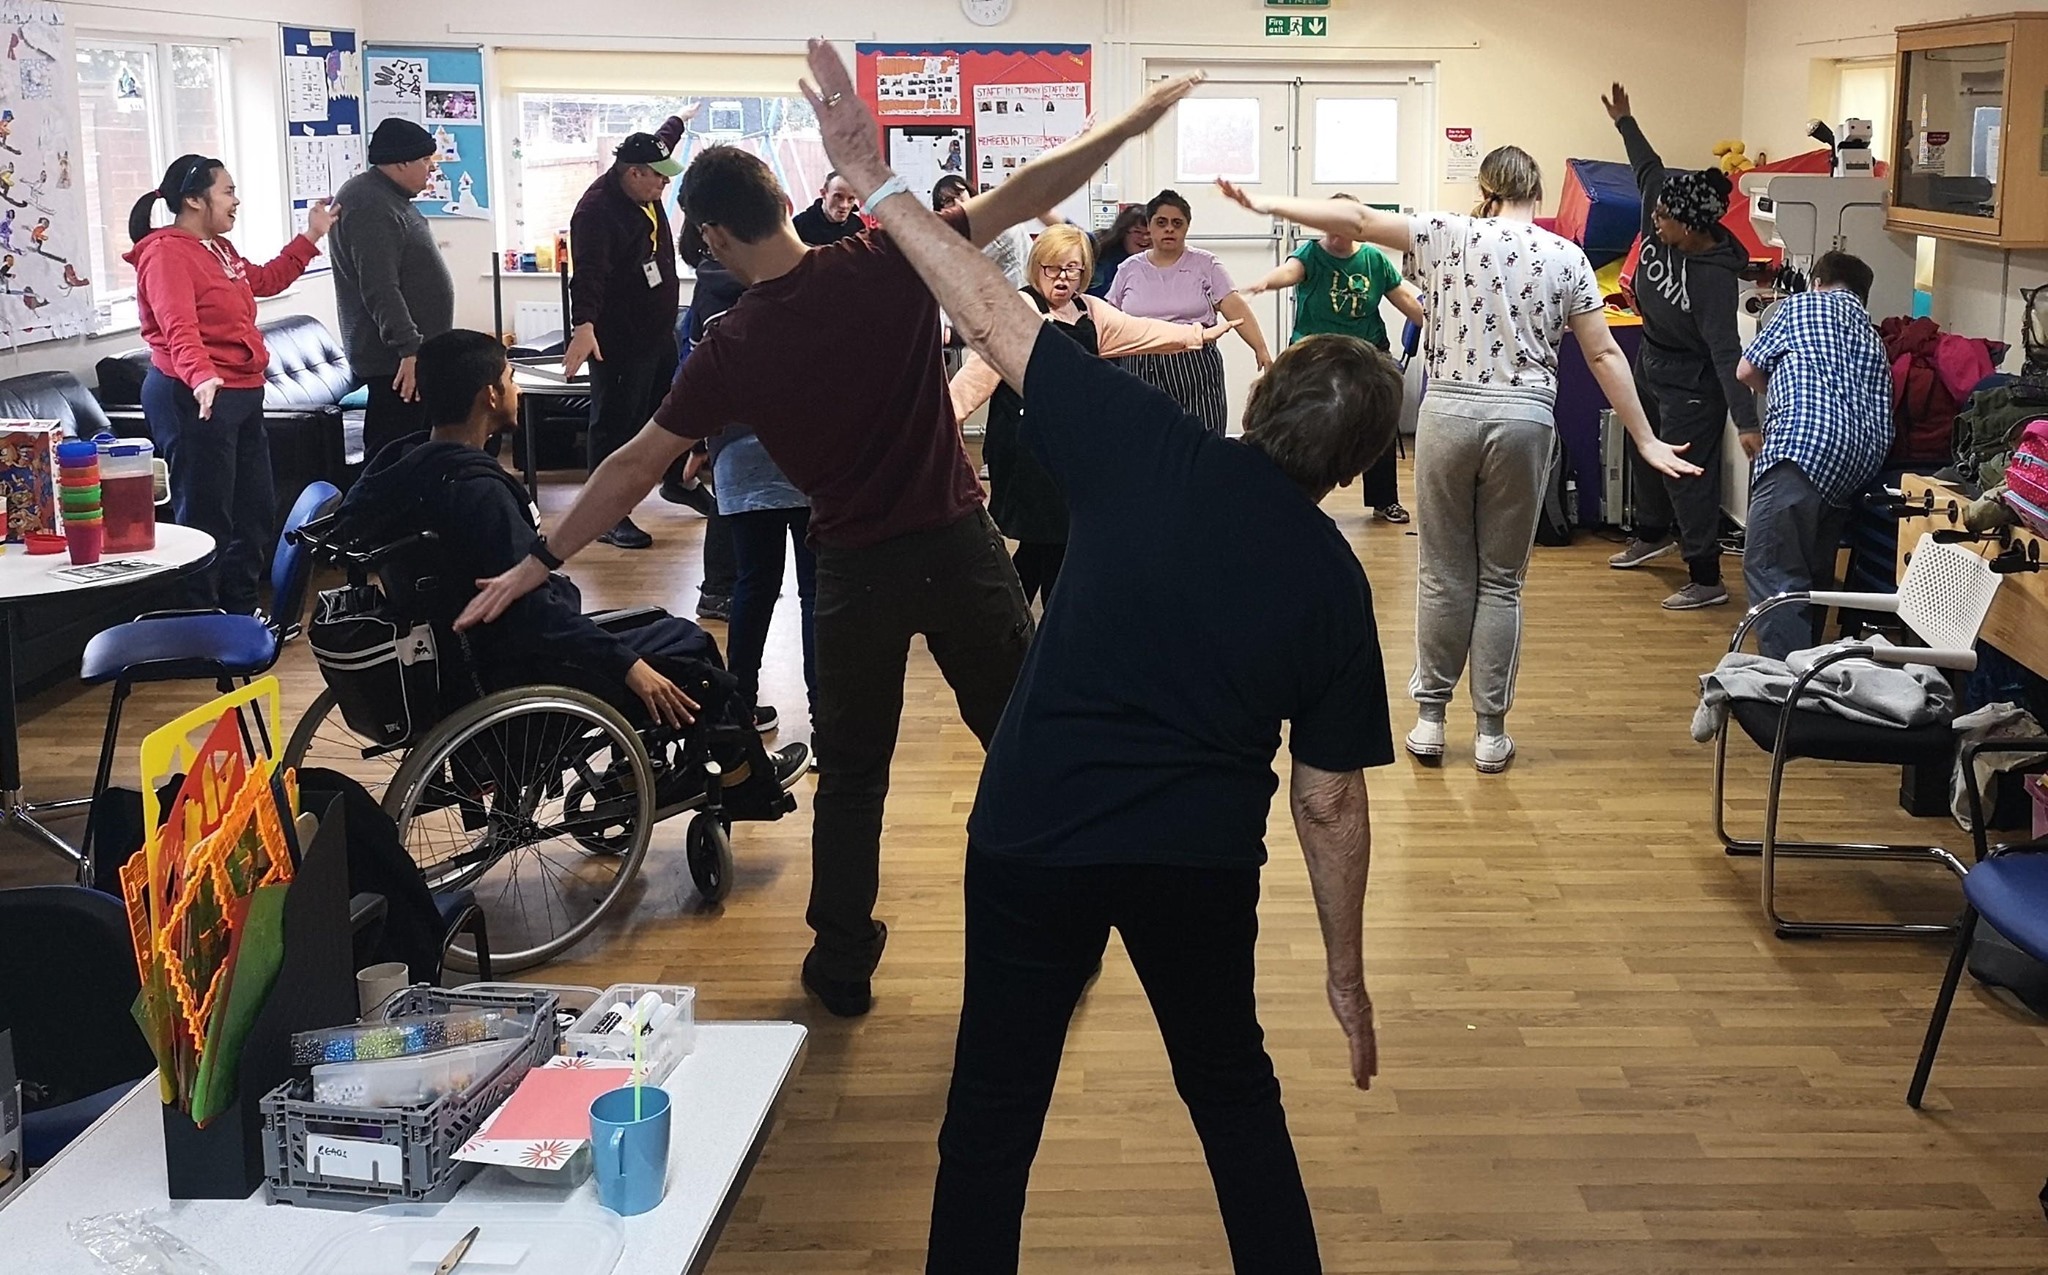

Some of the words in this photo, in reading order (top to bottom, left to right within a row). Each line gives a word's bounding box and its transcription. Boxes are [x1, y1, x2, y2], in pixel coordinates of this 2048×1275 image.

[1268, 18, 1283, 26] Fire
[977, 86, 1003, 97] STAFF
[1005, 87, 1014, 95] IN
[1044, 85, 1062, 93] STAFF
[978, 136, 1009, 146] MEMBERS
[1010, 136, 1020, 146] IN
